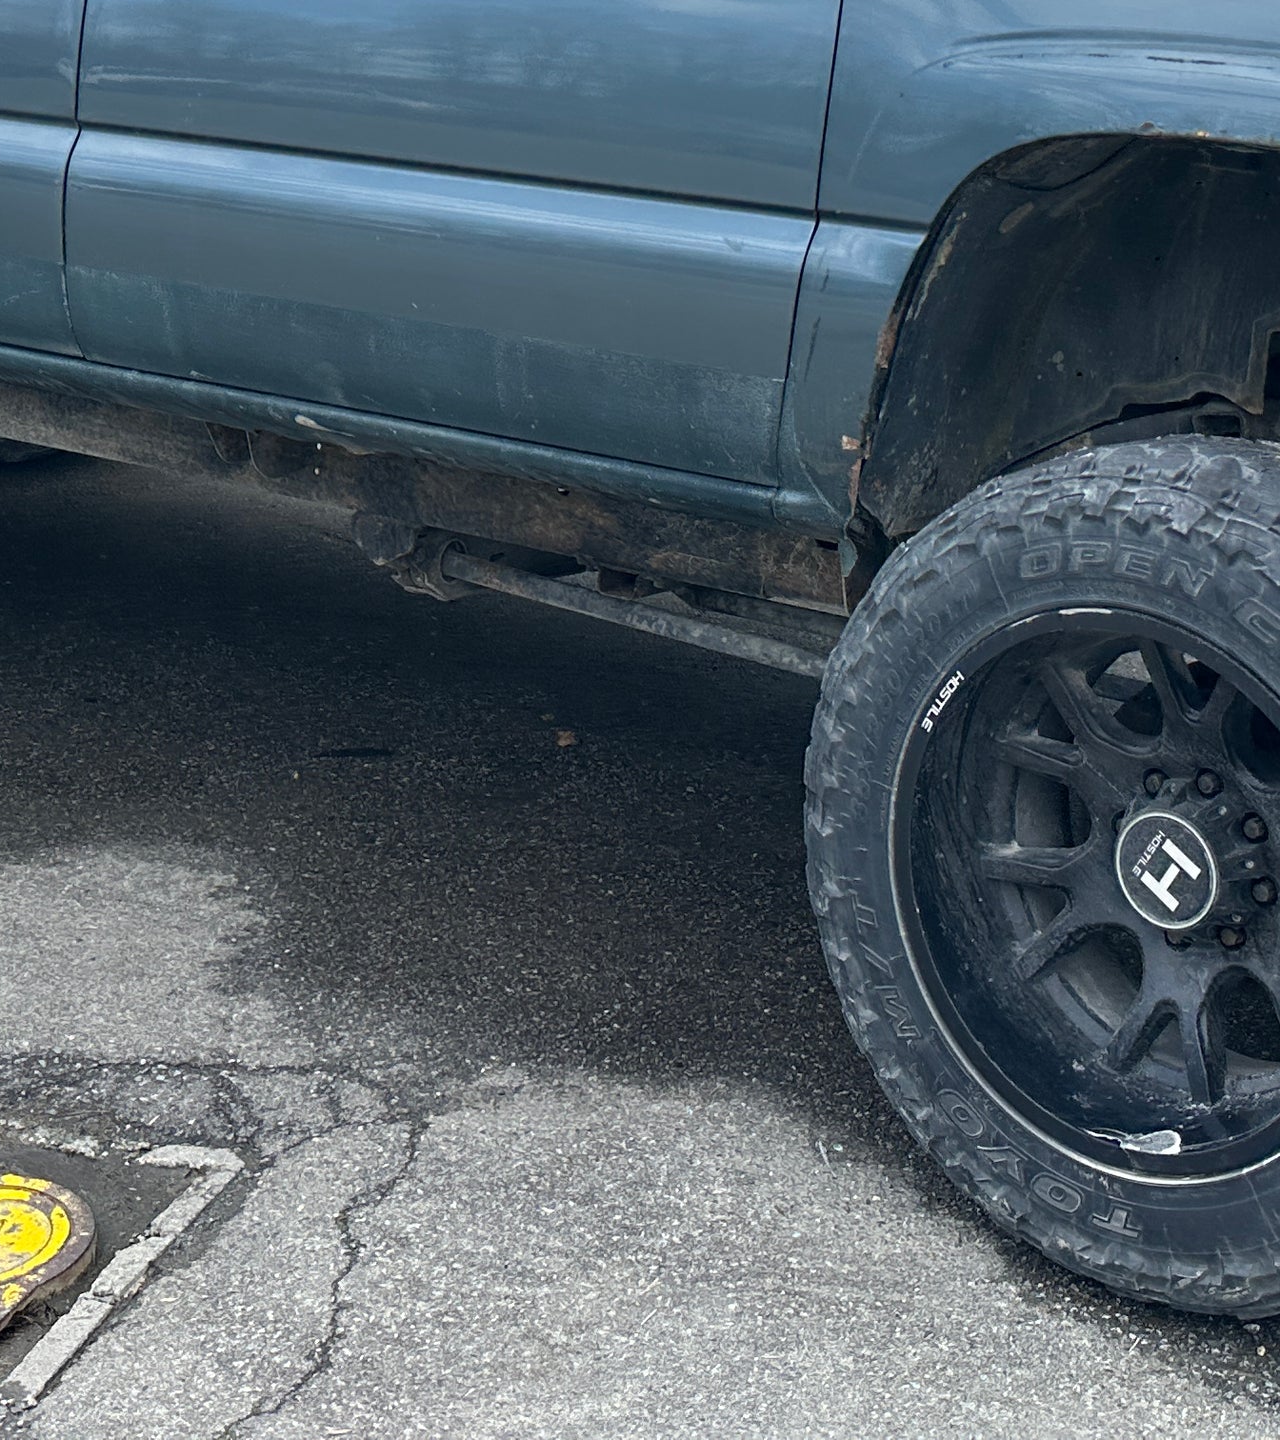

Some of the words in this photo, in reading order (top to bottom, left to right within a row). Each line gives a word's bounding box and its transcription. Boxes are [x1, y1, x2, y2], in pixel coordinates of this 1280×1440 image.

[1021, 540, 1217, 598] OPEN
[921, 670, 965, 733] HOSTILE
[1131, 830, 1166, 877] HOSTILE
[1140, 838, 1202, 912] H
[937, 1089, 1142, 1238] TOYO
